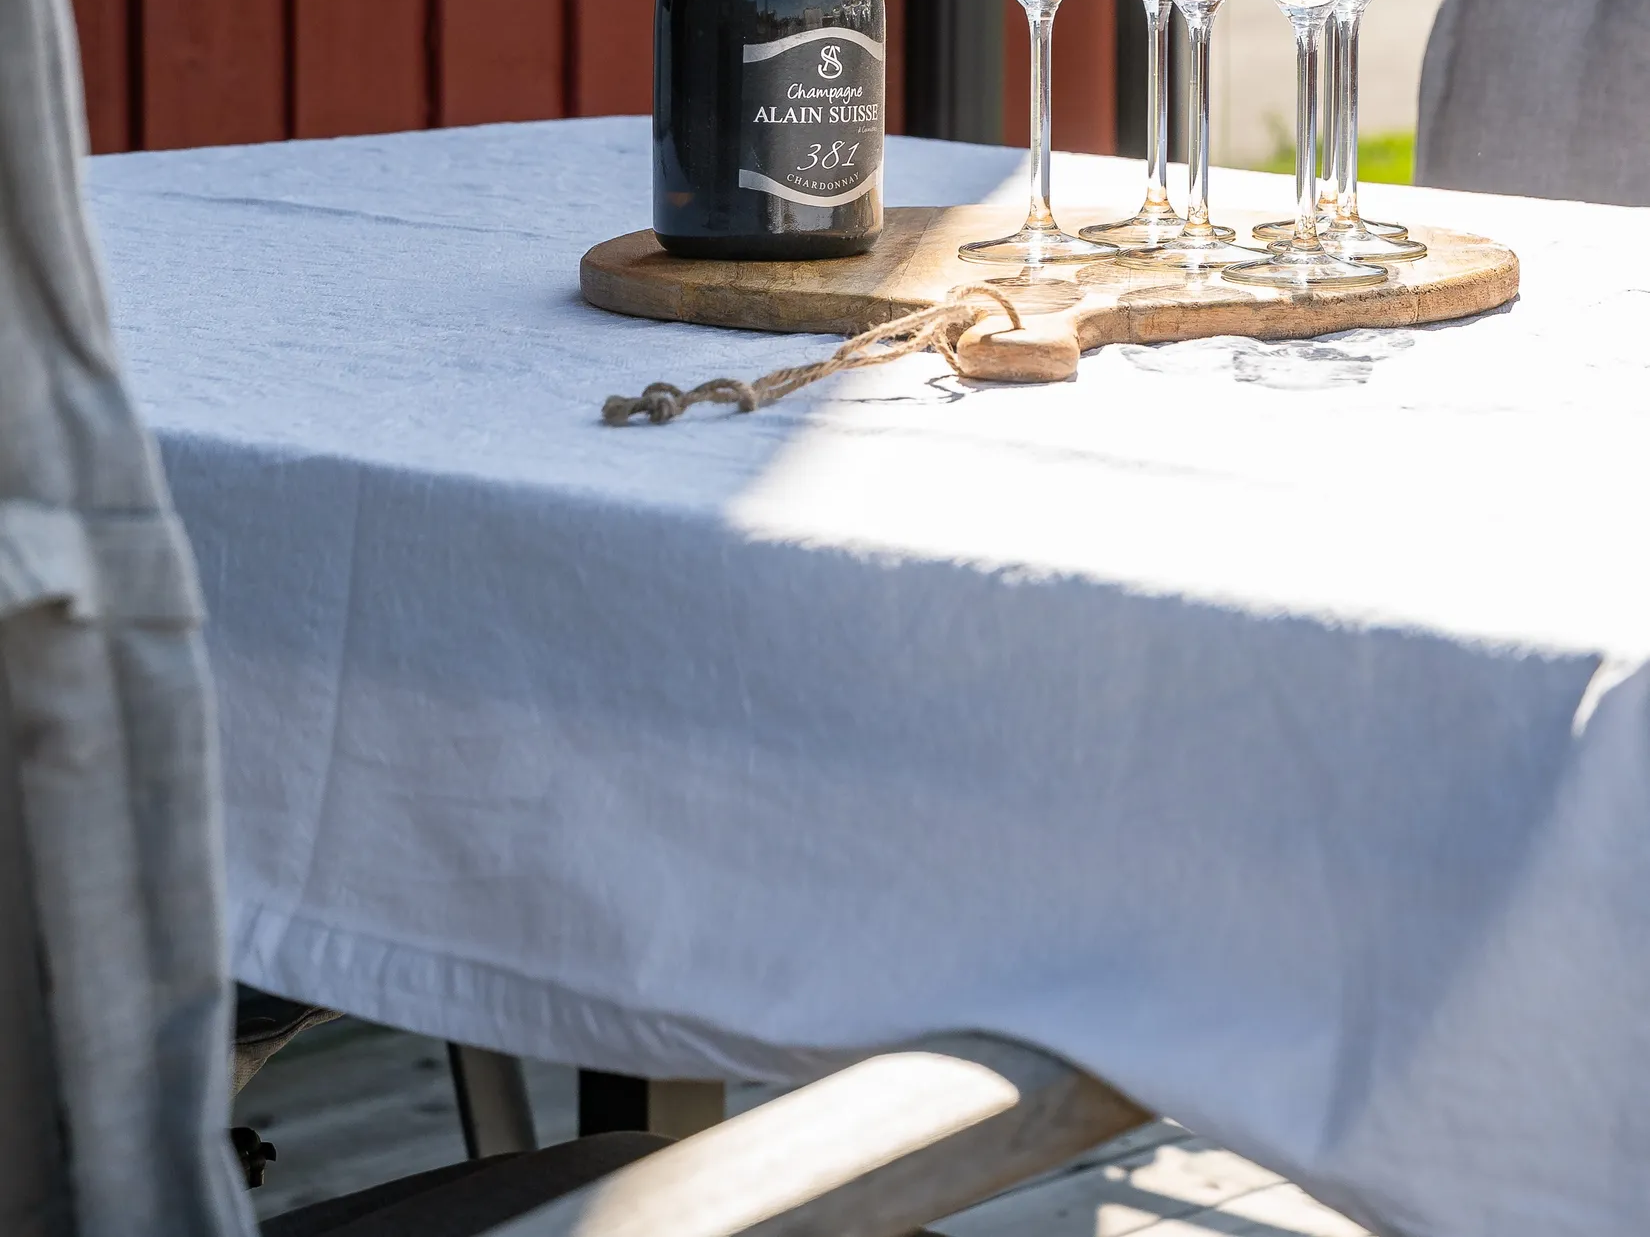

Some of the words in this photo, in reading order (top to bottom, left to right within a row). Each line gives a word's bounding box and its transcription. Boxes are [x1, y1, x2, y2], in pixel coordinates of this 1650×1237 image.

[787, 83, 864, 104] Champagne
[753, 106, 823, 124] ALAIN
[828, 103, 878, 123] SUISSE
[796, 140, 860, 171] 381
[786, 172, 859, 190] CHARDONNAY
